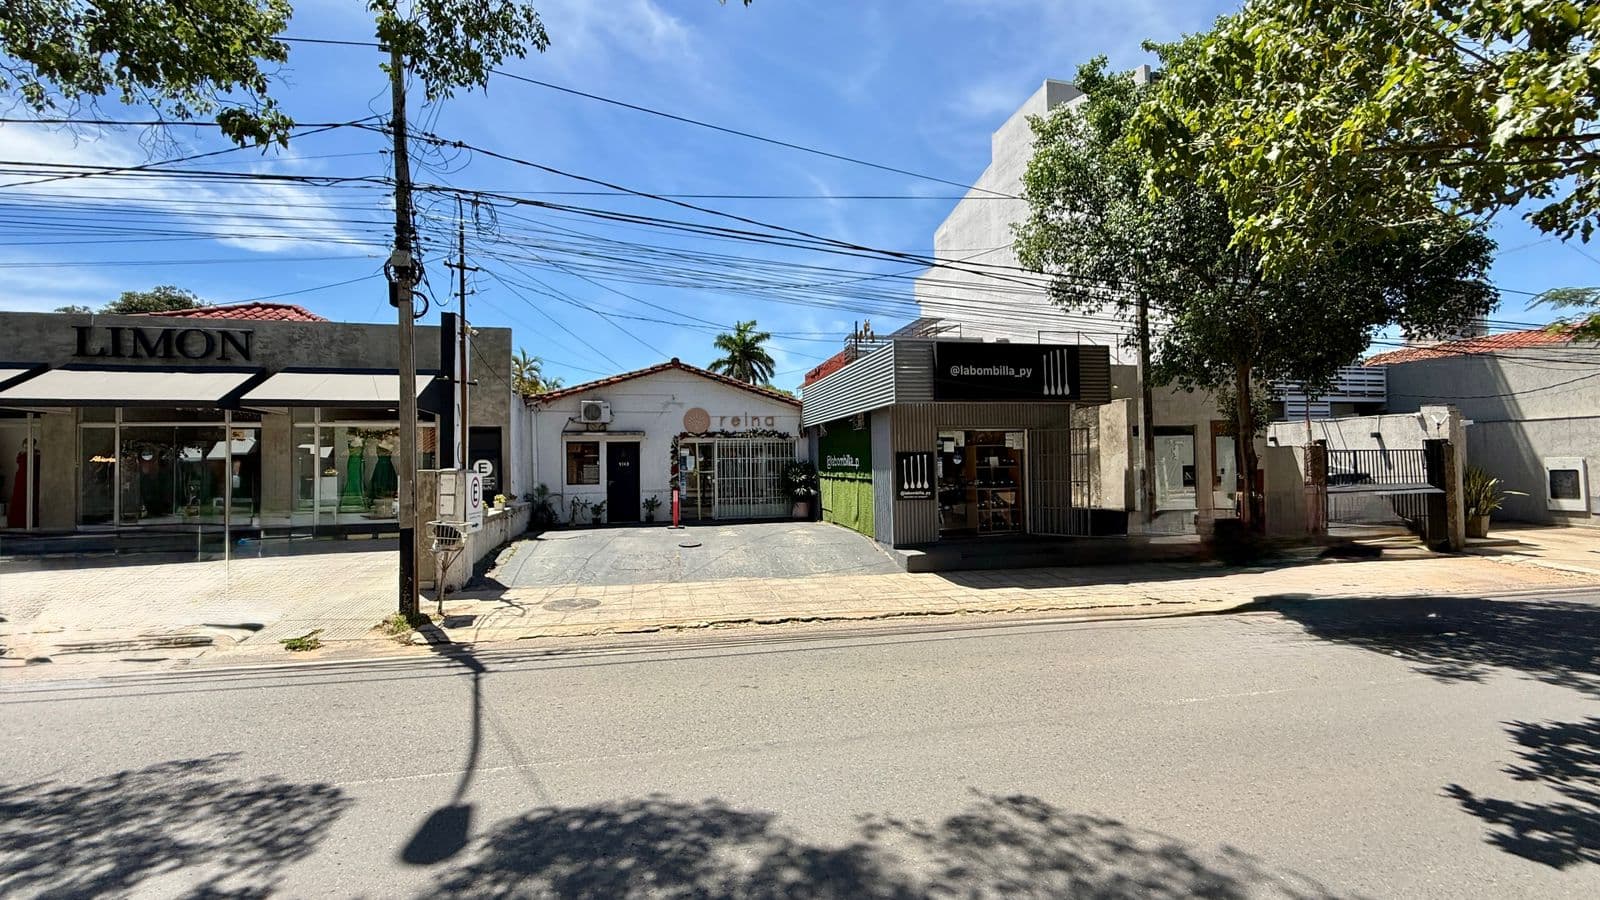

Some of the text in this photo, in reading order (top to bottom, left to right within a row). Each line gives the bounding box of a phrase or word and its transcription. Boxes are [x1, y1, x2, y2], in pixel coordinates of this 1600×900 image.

[72, 325, 253, 361] LIMON
[950, 365, 1032, 378] @labombilla_py
[720, 411, 774, 427] reina
[478, 463, 488, 473] E
[473, 483, 478, 502] E
